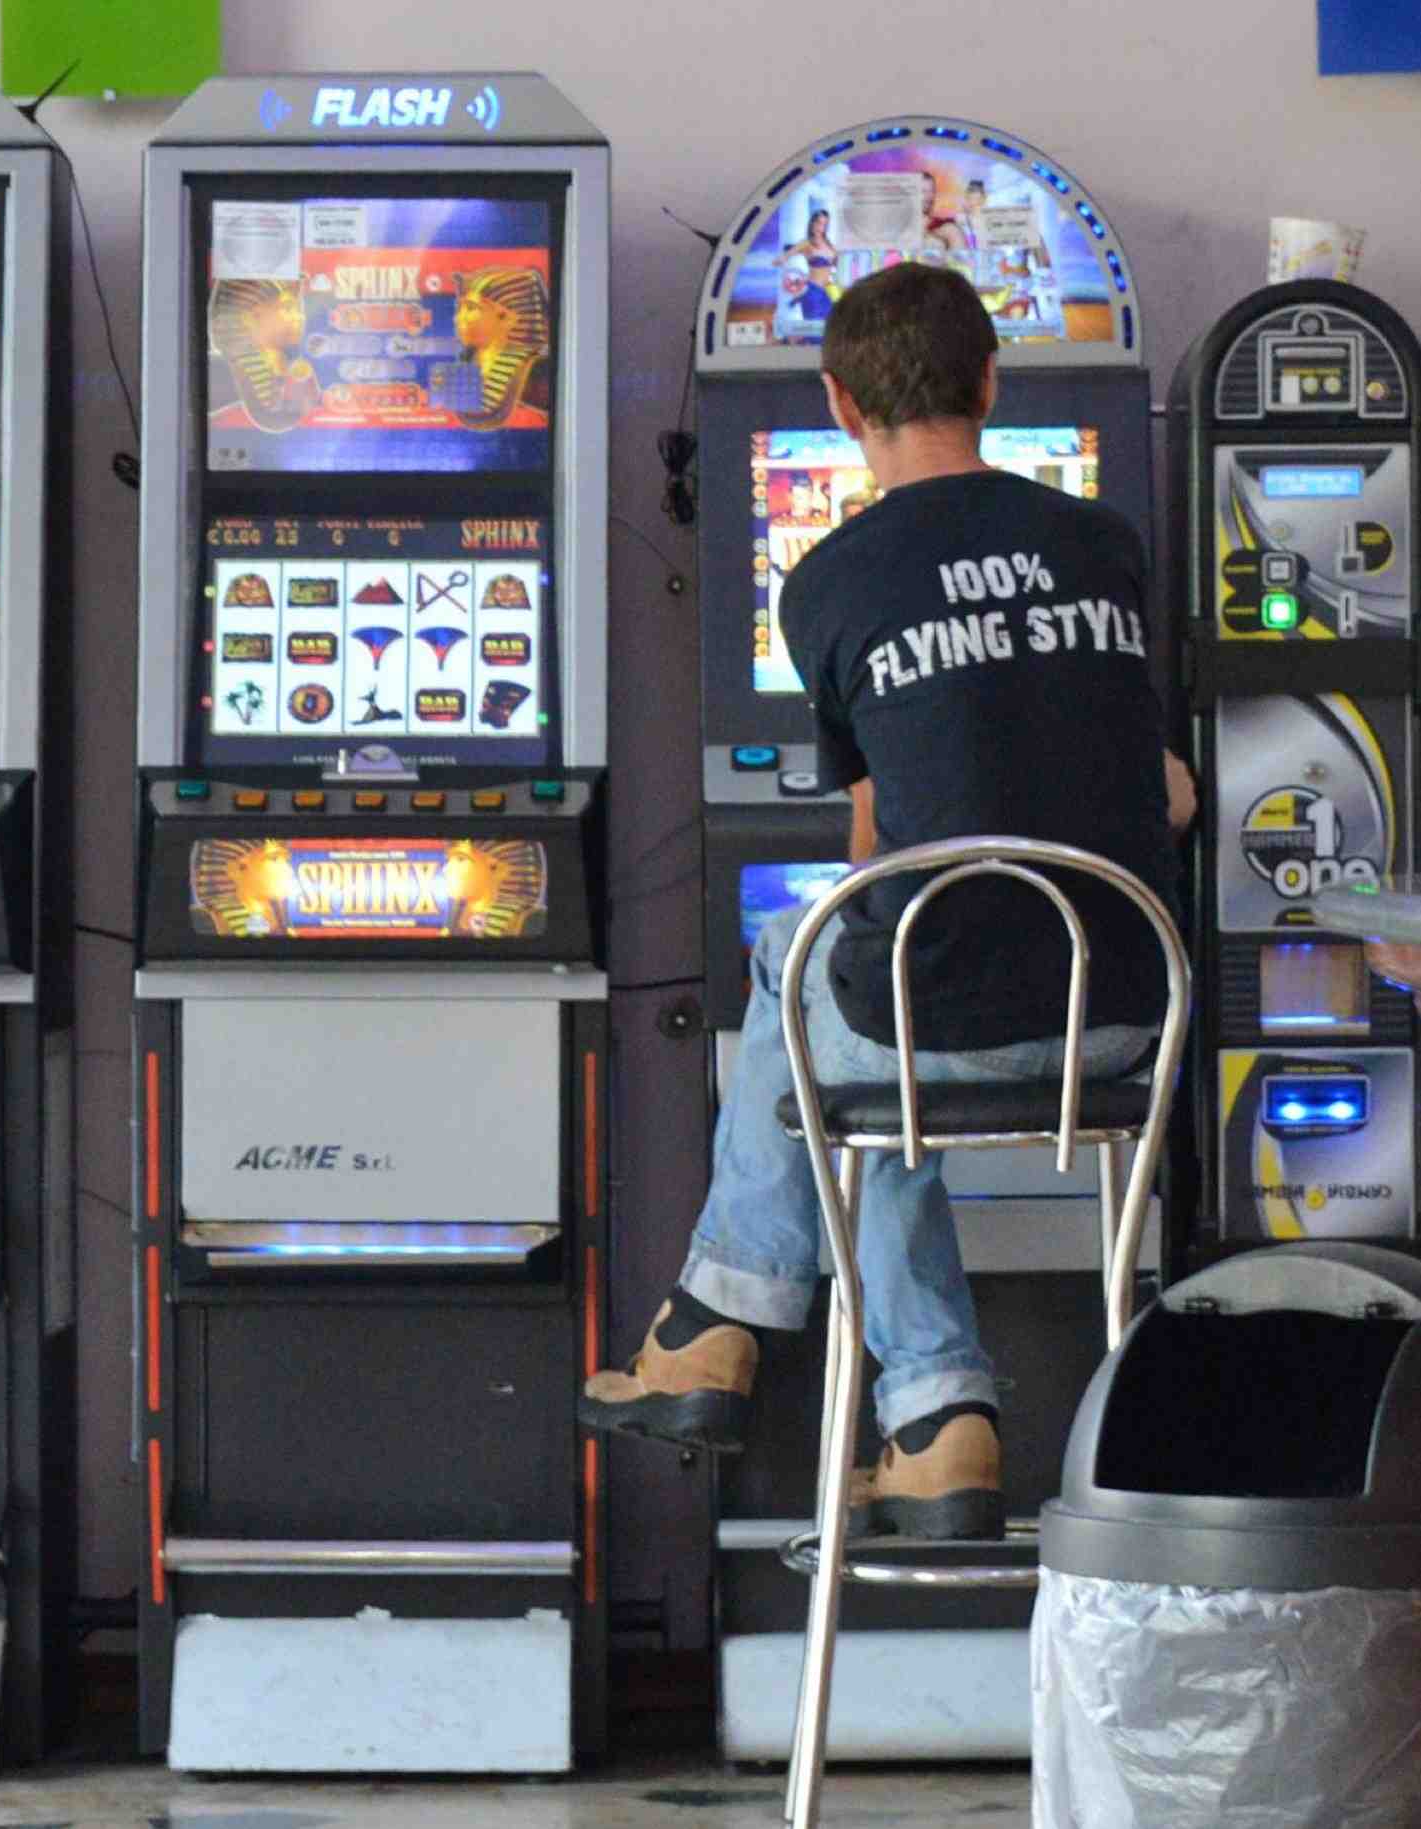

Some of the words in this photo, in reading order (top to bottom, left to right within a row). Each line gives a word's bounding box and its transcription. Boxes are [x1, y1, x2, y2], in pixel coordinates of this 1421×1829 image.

[310, 87, 452, 127] FLASH
[333, 265, 422, 299] SPHINX
[461, 520, 541, 549] SPHINX
[938, 552, 1055, 603] 100%
[866, 611, 1013, 696] FLYING
[297, 861, 441, 916] SPHINX
[235, 1144, 342, 1172] ACME
